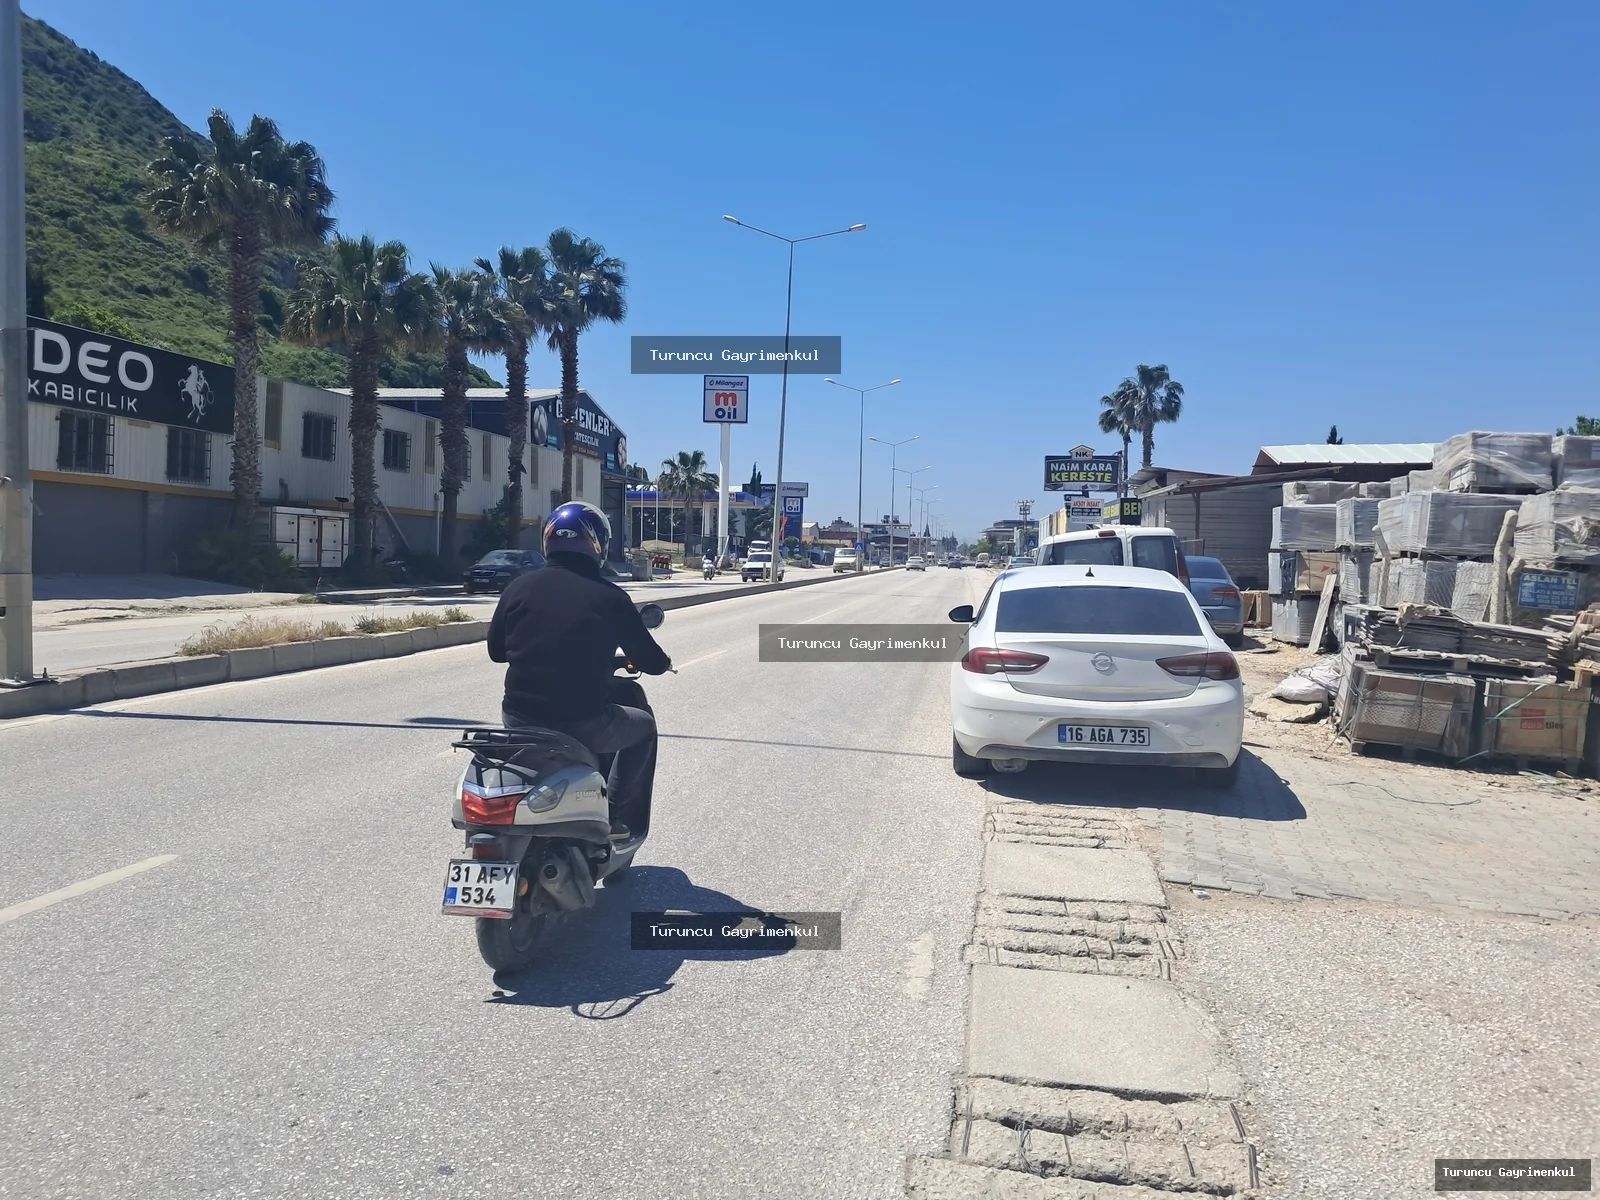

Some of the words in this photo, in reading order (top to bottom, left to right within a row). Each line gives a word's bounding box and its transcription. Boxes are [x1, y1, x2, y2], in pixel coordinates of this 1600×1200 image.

[33, 329, 154, 391] DEO
[715, 380, 744, 388] Milangaz
[715, 392, 737, 406] m
[1084, 463, 1112, 471] KARA
[1051, 472, 1112, 482] KERESTE
[1523, 575, 1557, 584] ASLAN
[1068, 727, 1083, 741] 16
[1090, 728, 1114, 742] AGA
[1120, 729, 1146, 743] 735
[451, 866, 470, 882] 31
[477, 866, 514, 885] AFY
[461, 887, 496, 905] 534
